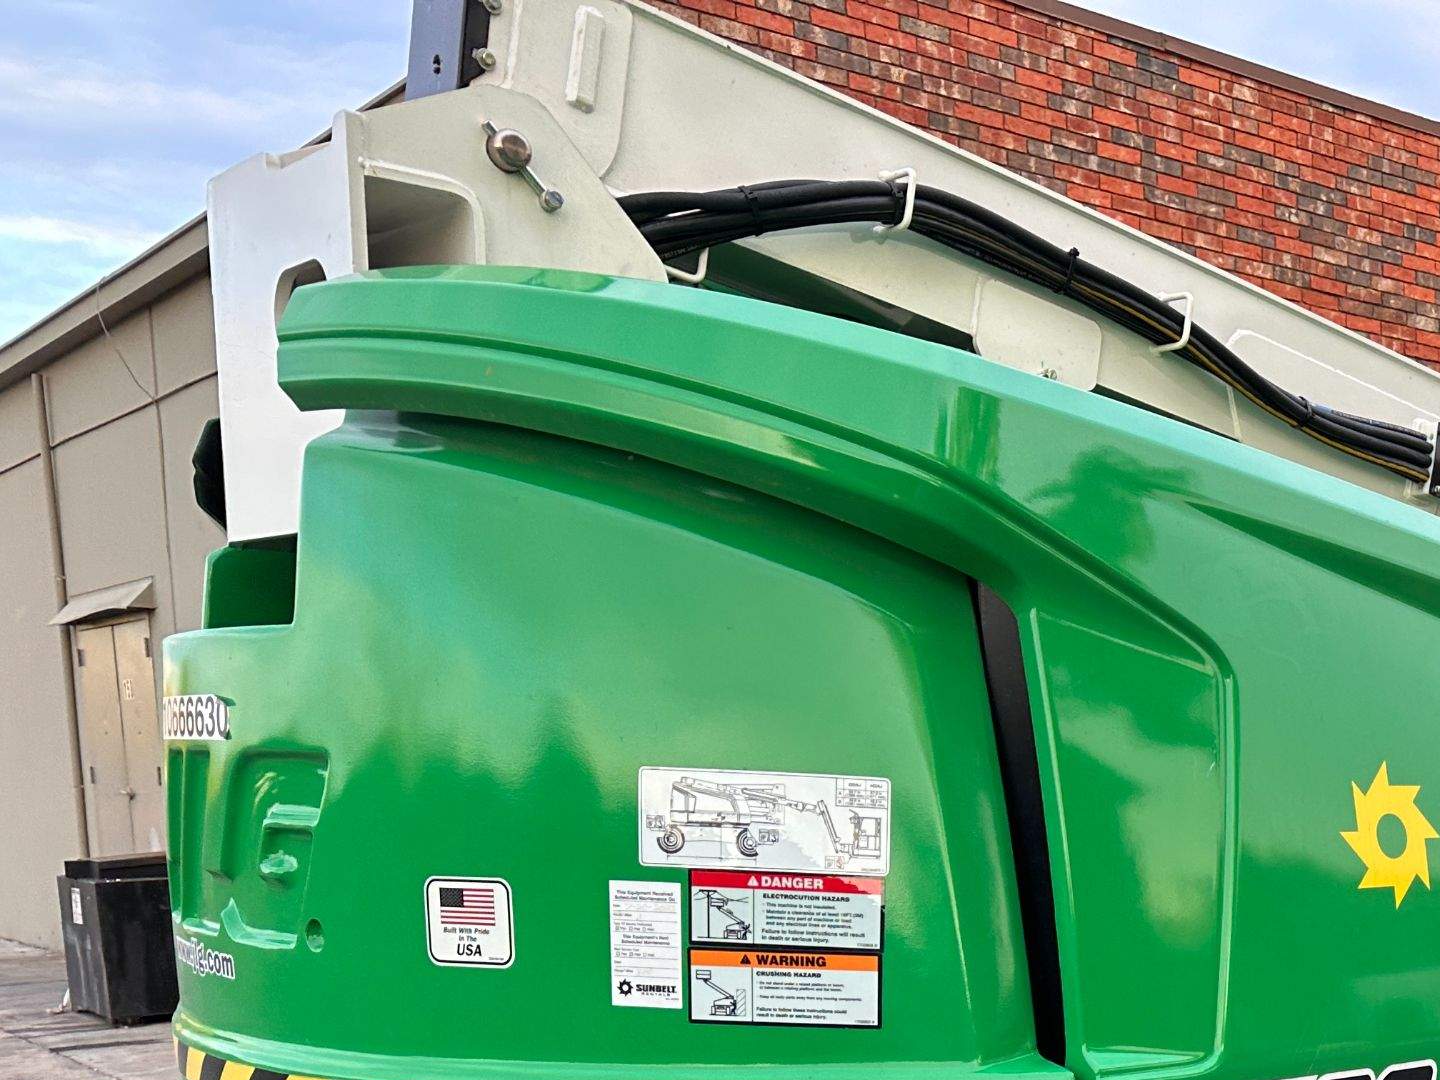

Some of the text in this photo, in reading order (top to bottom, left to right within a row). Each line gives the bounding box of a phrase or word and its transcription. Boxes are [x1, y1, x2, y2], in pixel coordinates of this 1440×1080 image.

[761, 876, 824, 889] DANGER
[763, 893, 820, 901] ELECTROCUTION
[457, 944, 482, 957] USA
[756, 954, 826, 967] WARNING
[636, 984, 677, 994] SUNBELT
